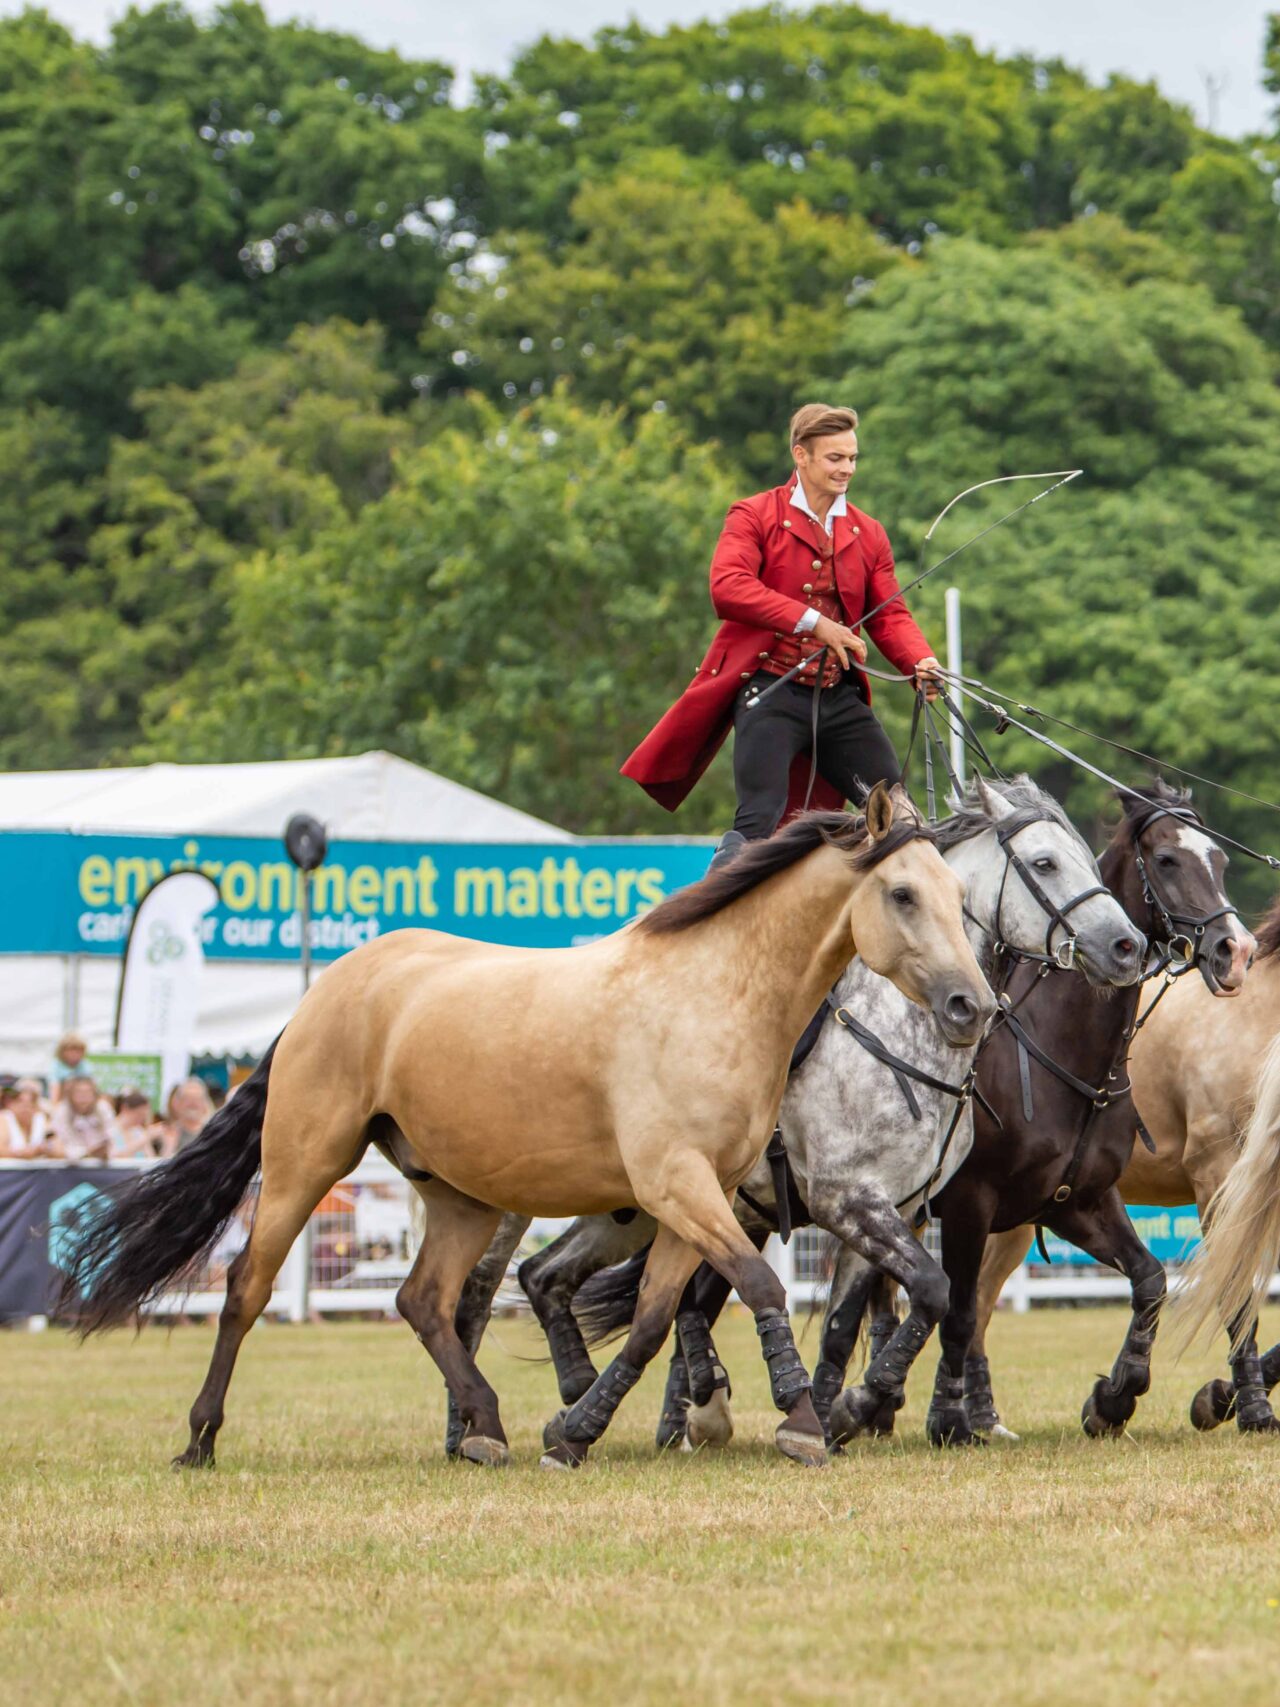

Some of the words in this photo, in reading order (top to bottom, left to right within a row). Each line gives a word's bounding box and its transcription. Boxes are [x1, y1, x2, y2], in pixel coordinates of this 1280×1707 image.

[453, 856, 666, 918] matters
[222, 916, 274, 946] our
[279, 909, 380, 950] dstrict
